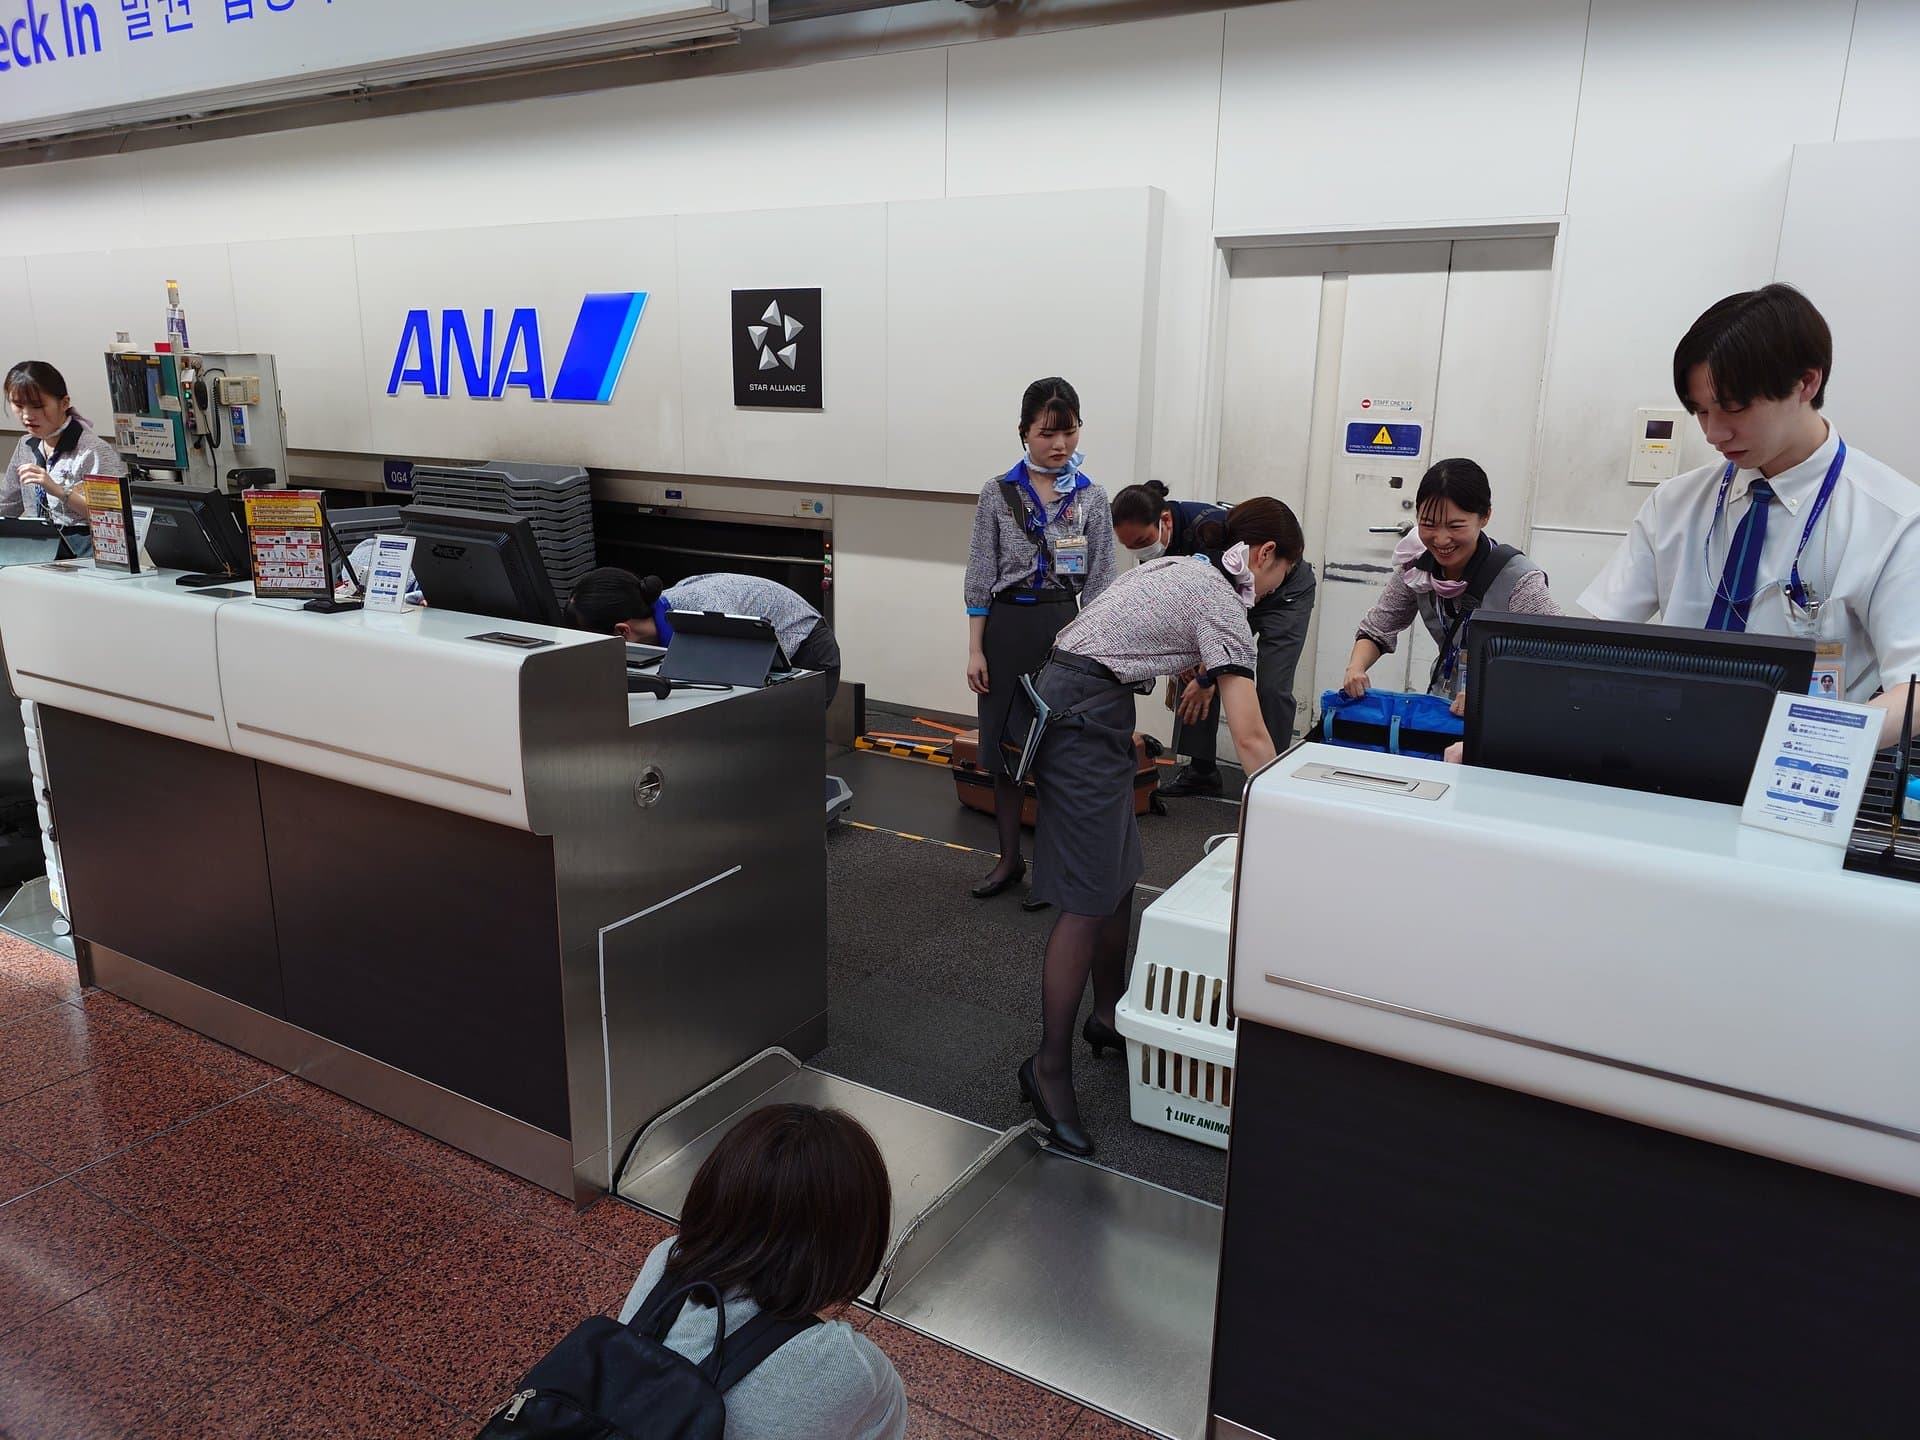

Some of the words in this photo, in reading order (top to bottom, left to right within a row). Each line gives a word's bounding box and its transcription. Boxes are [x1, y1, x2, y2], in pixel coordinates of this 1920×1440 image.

[60, 0, 101, 57] In
[387, 308, 548, 400] ANA
[749, 383, 768, 391] STAR
[769, 384, 807, 392] ALLIANCE
[1174, 1110, 1196, 1125] LIVE
